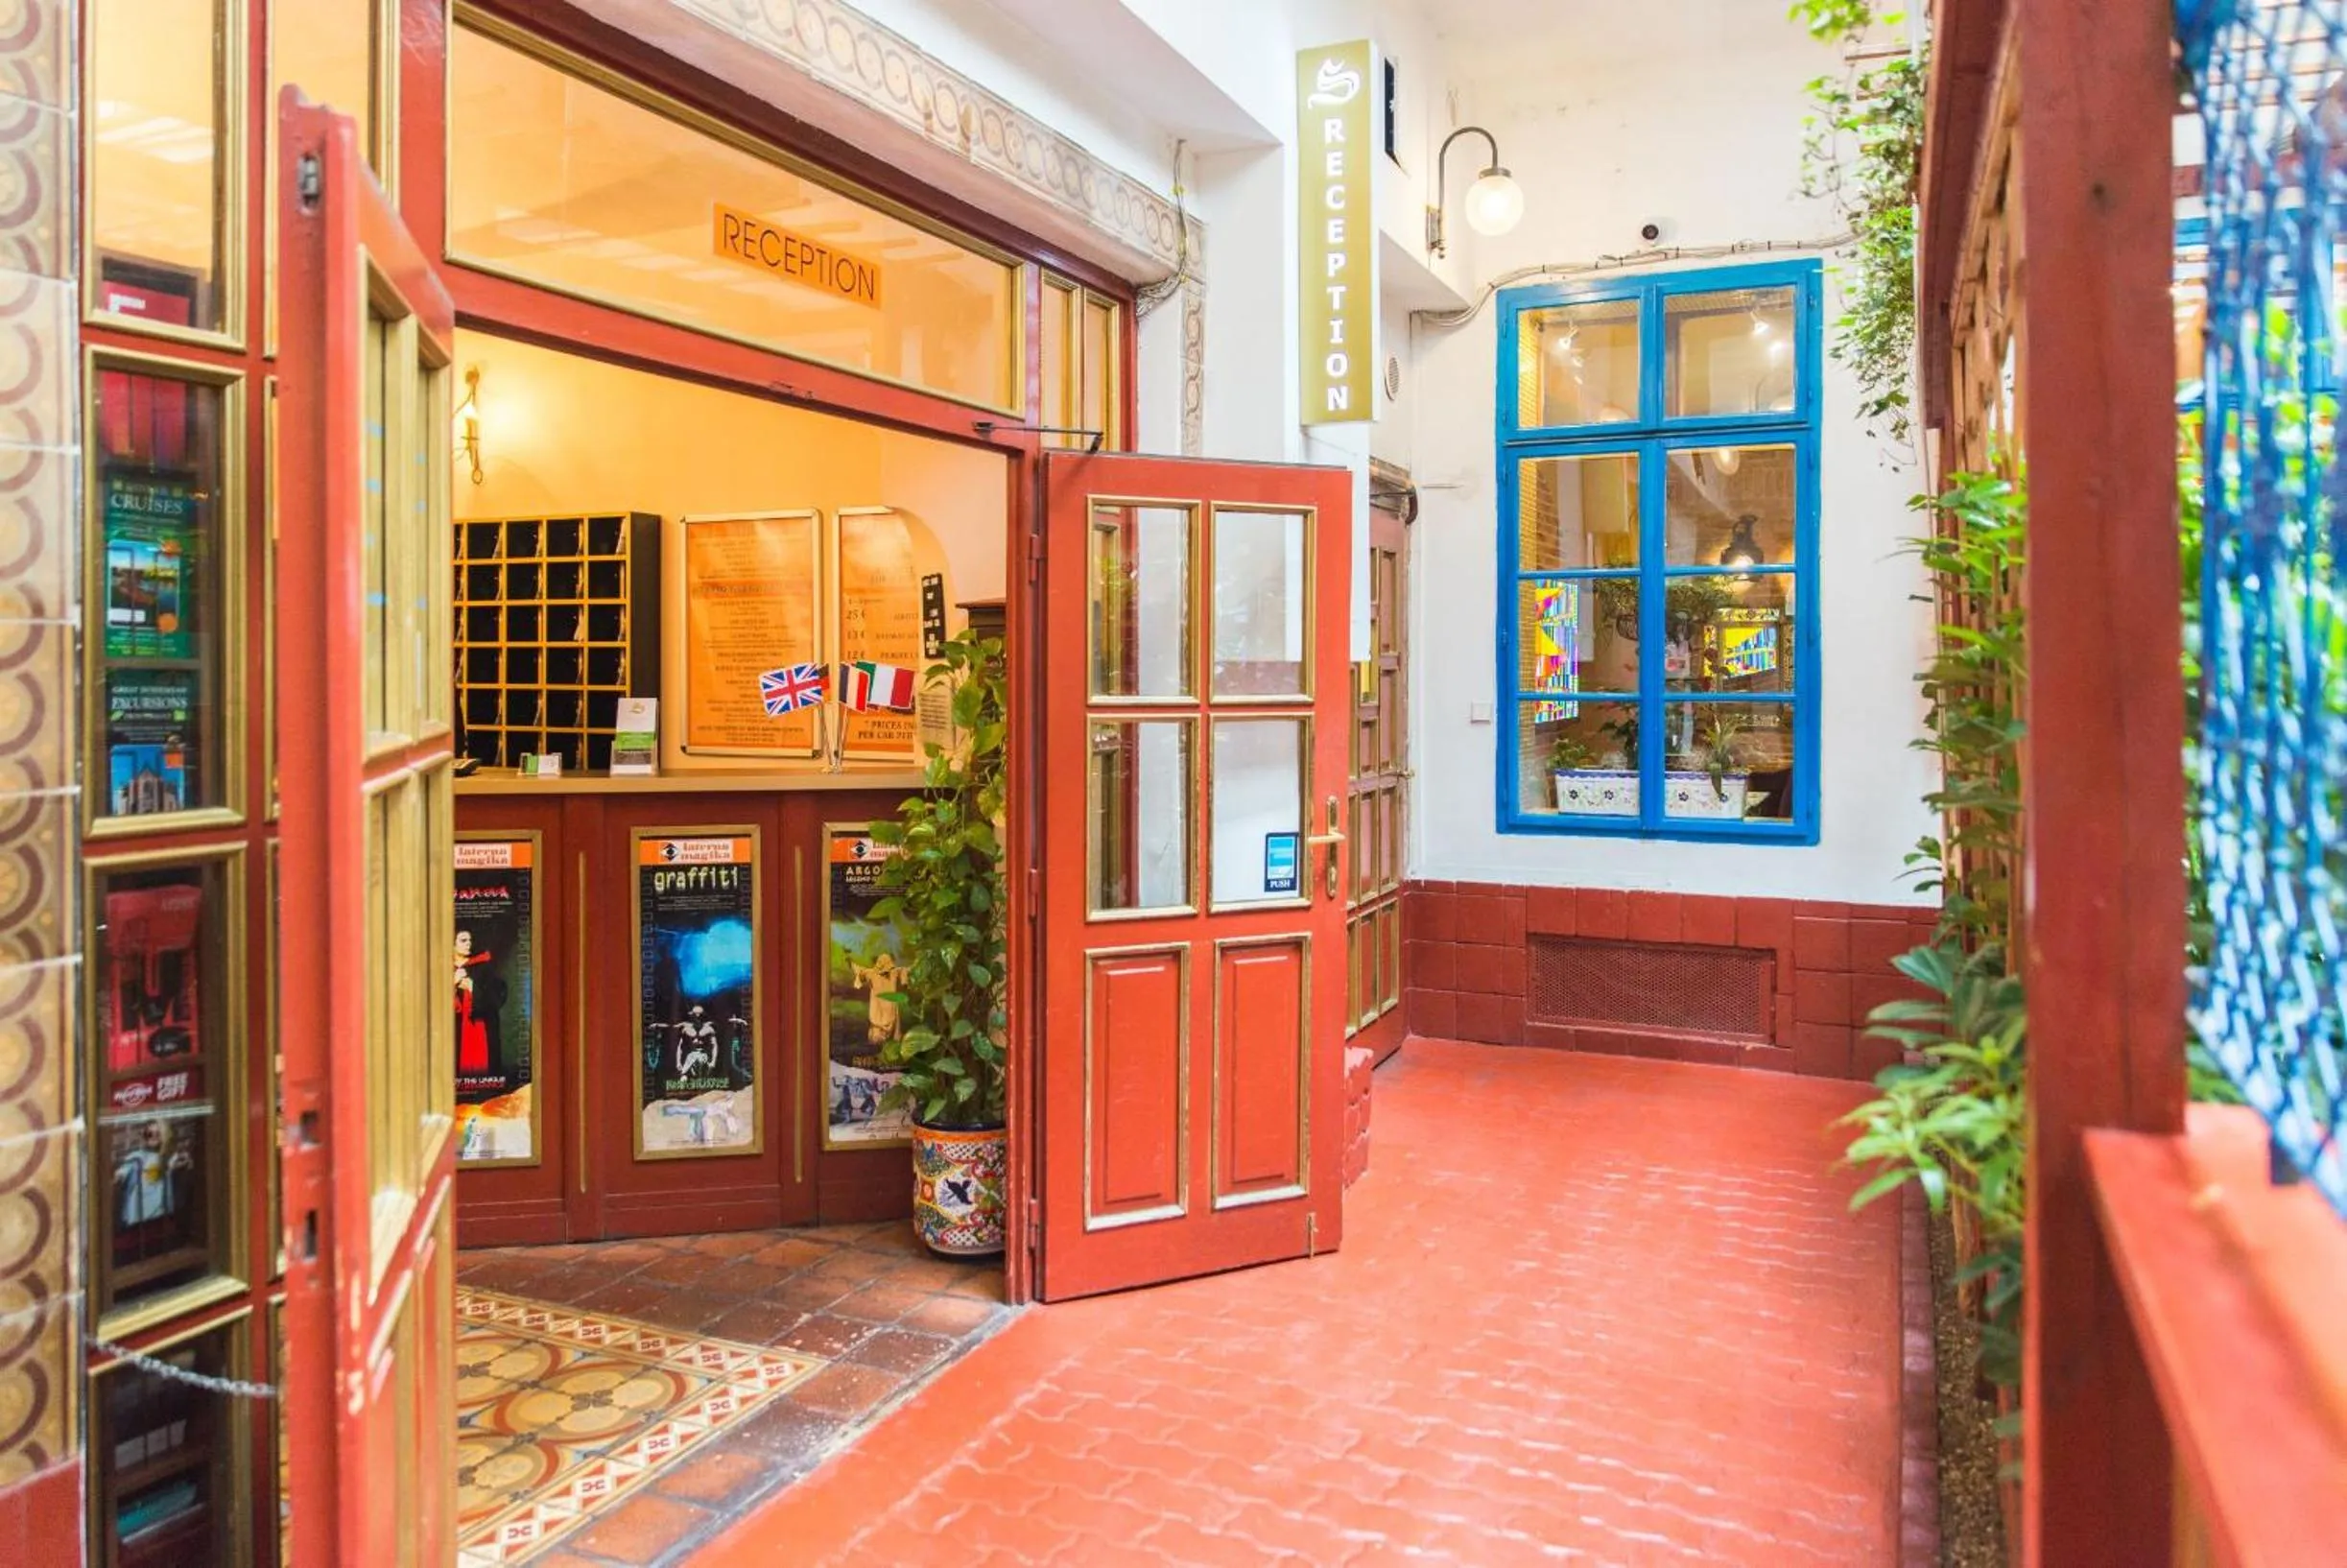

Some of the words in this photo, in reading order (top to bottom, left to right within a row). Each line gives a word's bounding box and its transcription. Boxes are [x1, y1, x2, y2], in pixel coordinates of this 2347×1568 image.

[723, 212, 875, 301] RECEPTION
[1324, 117, 1349, 412] RECEPTION
[110, 492, 183, 514] CRUISES
[654, 866, 739, 892] graffiti
[845, 866, 881, 875] ARGO
[1269, 879, 1291, 889] PUSH
